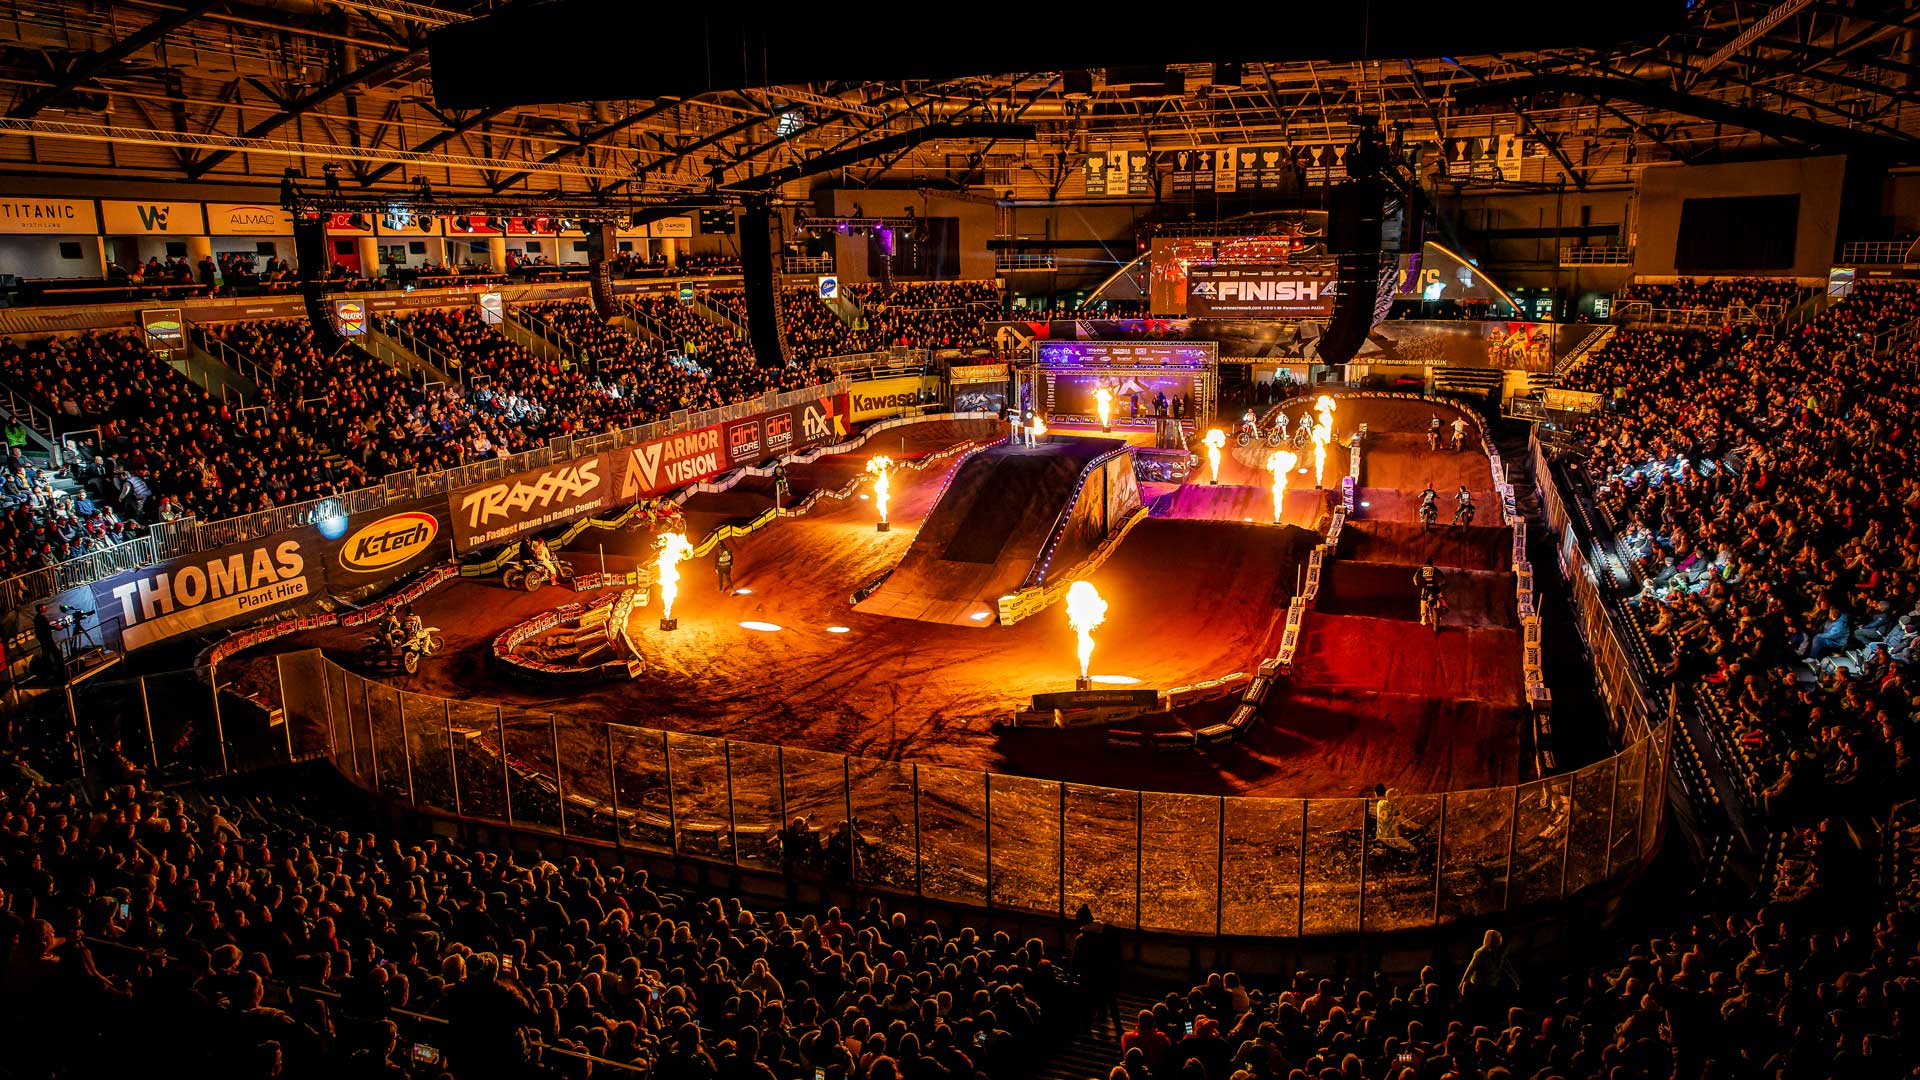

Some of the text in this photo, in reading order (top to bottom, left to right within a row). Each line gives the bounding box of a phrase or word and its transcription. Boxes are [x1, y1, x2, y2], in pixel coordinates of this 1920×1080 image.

[2, 203, 74, 219] TITANIC
[230, 214, 276, 225] ALMAC
[1218, 281, 1318, 301] FINISH
[339, 311, 363, 321] WALKERS
[767, 415, 791, 437] dirt
[732, 424, 758, 447] dirt
[768, 431, 792, 445] STORE
[806, 432, 825, 442] AUTO
[663, 429, 719, 462] ARMOR
[732, 441, 759, 455] STORE
[665, 452, 718, 484] VISION
[460, 458, 601, 529] TRAXXAS
[469, 535, 486, 547] The
[485, 524, 518, 542] Fastest
[518, 516, 542, 535] Name
[552, 507, 575, 521] Radio
[575, 499, 602, 516] Control
[113, 540, 304, 627] THOMAS
[424, 573, 441, 587] dirt
[577, 573, 601, 588] dirt
[611, 573, 626, 583] dirt
[238, 580, 304, 610] Plant Hire
[297, 615, 317, 627] dirt
[318, 612, 337, 623] dirt
[540, 614, 558, 628] dirt
[276, 620, 295, 633] dirt
[524, 620, 540, 634] dirt
